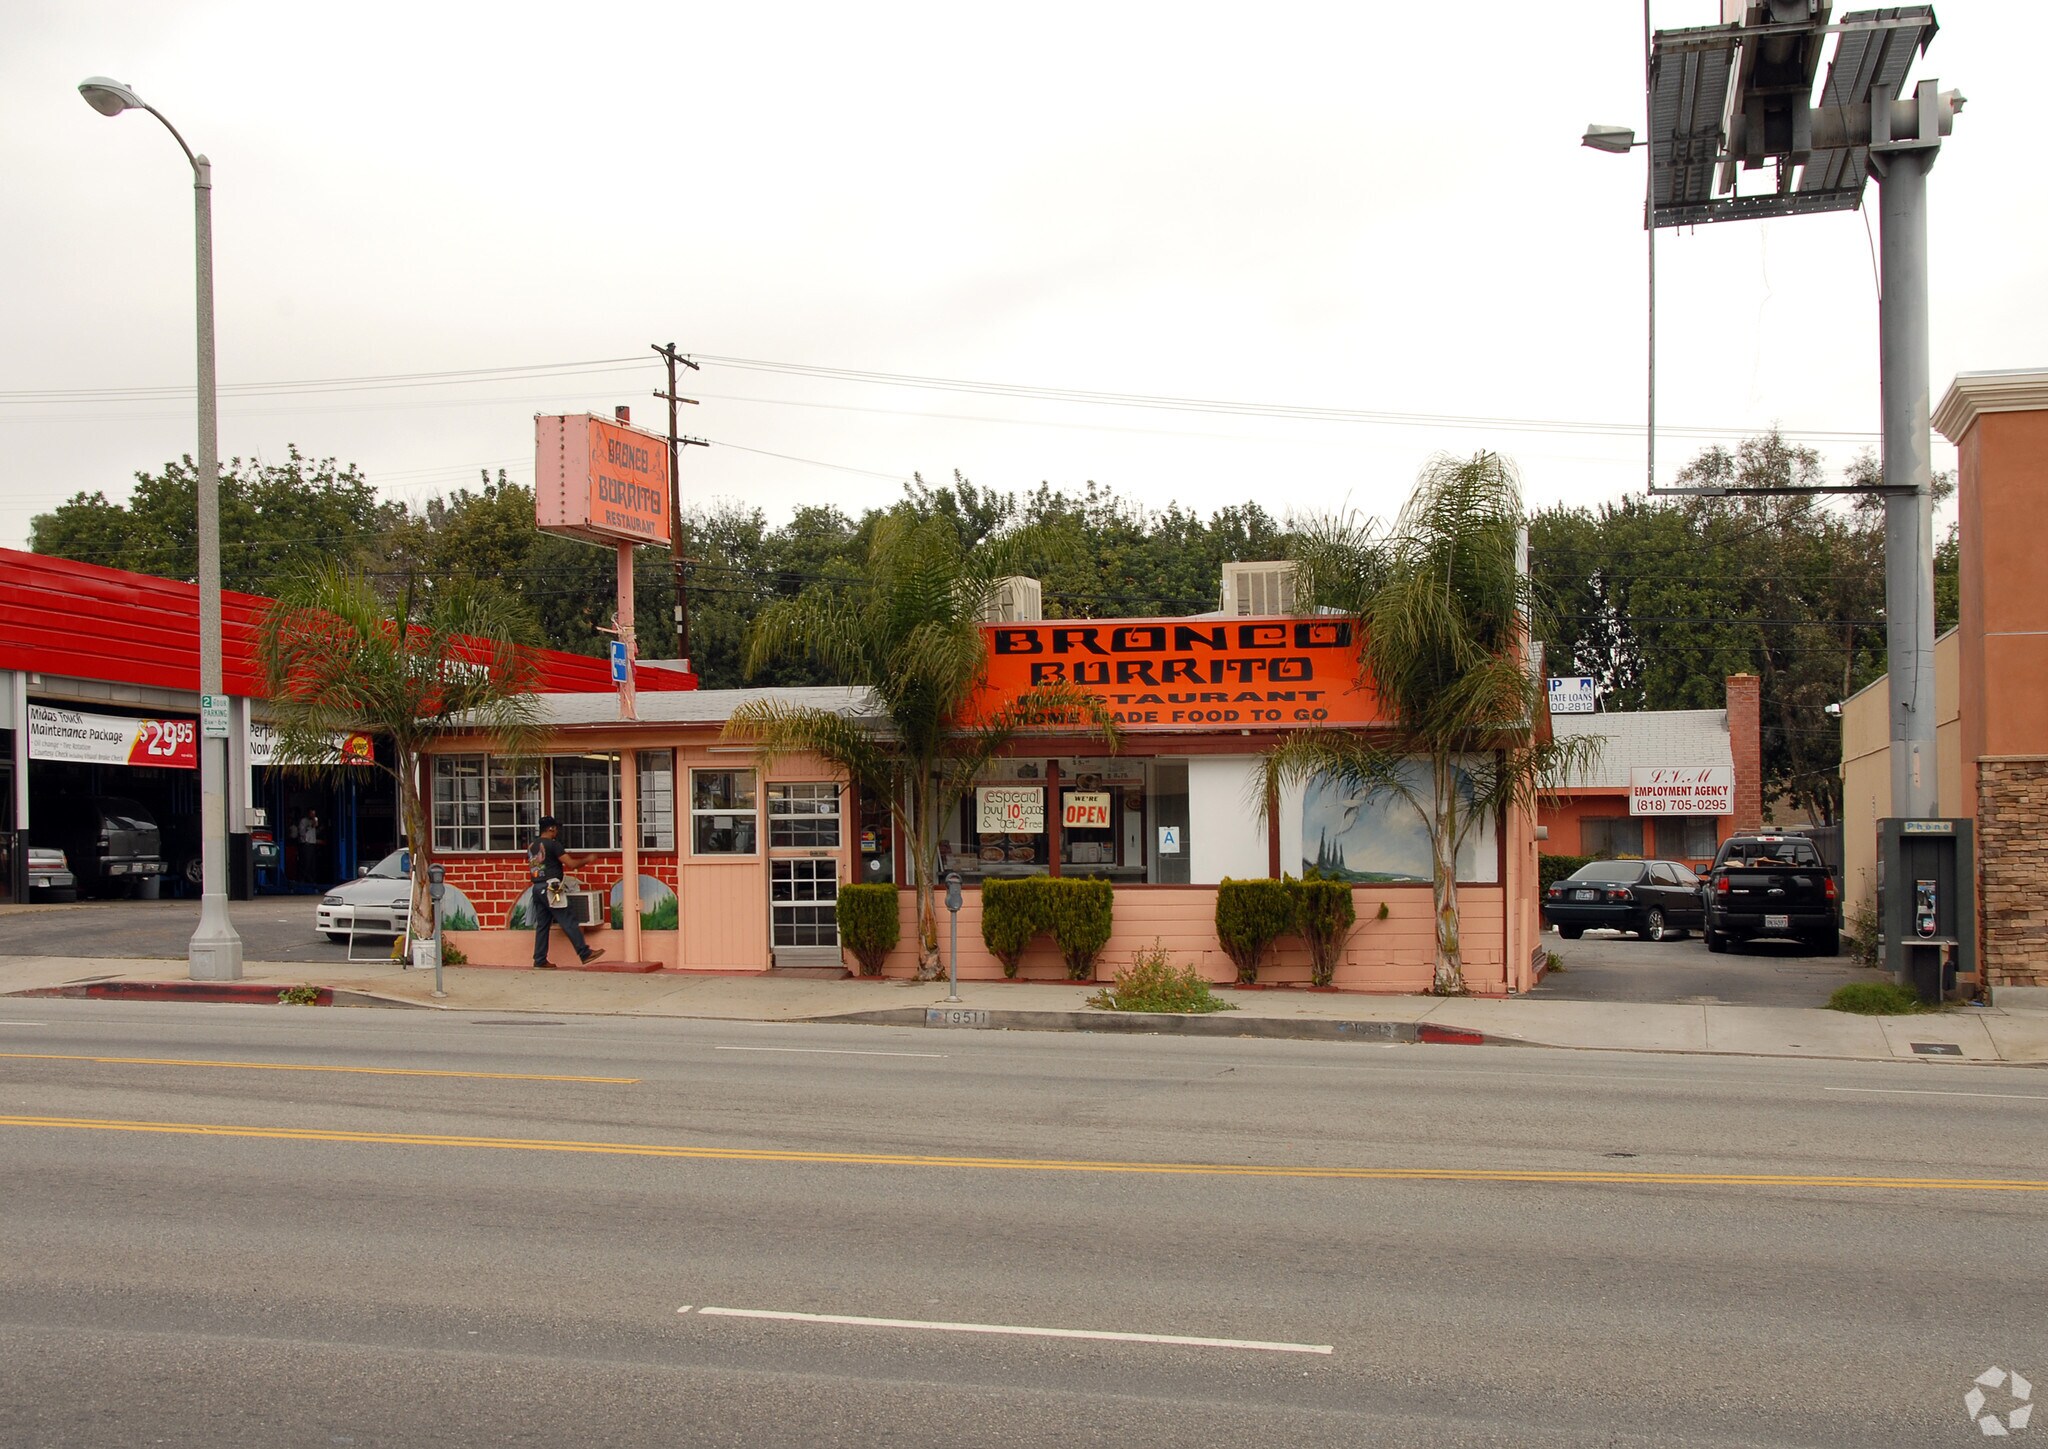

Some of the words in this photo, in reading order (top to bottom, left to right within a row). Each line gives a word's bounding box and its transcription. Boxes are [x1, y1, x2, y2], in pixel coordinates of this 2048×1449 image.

[599, 475, 661, 515] BURRITO
[605, 509, 656, 536] RESTAURANT
[994, 623, 1351, 656] BRONCO
[1030, 656, 1314, 687] BURRITO
[203, 697, 210, 707] 2
[1017, 691, 1326, 706] STAURANT
[1569, 693, 1593, 702] LOANS
[30, 707, 58, 723] Midas
[59, 711, 83, 725] Touch
[203, 709, 227, 718] PARKING
[1172, 709, 1239, 723] FOOD
[1250, 709, 1282, 722] TO
[1294, 708, 1328, 721] GO
[30, 722, 87, 740] Maintenance
[89, 729, 124, 745] Package
[250, 742, 271, 756] Now
[984, 789, 1042, 806] especial
[1634, 786, 1692, 797] EMPLOYMENT
[1694, 786, 1729, 797] AGENCY
[983, 802, 1004, 821] buy
[1007, 804, 1021, 819] 10
[1637, 800, 1666, 812] (818)
[1670, 800, 1727, 811] 705-0295
[1066, 805, 1108, 824] OPEN
[983, 815, 992, 829] &
[1001, 818, 1018, 834] get
[1017, 818, 1024, 831] 2
[1024, 817, 1043, 829] free
[1906, 822, 1950, 831] Phone
[1164, 831, 1175, 844] A
[944, 1012, 986, 1024] 19511
